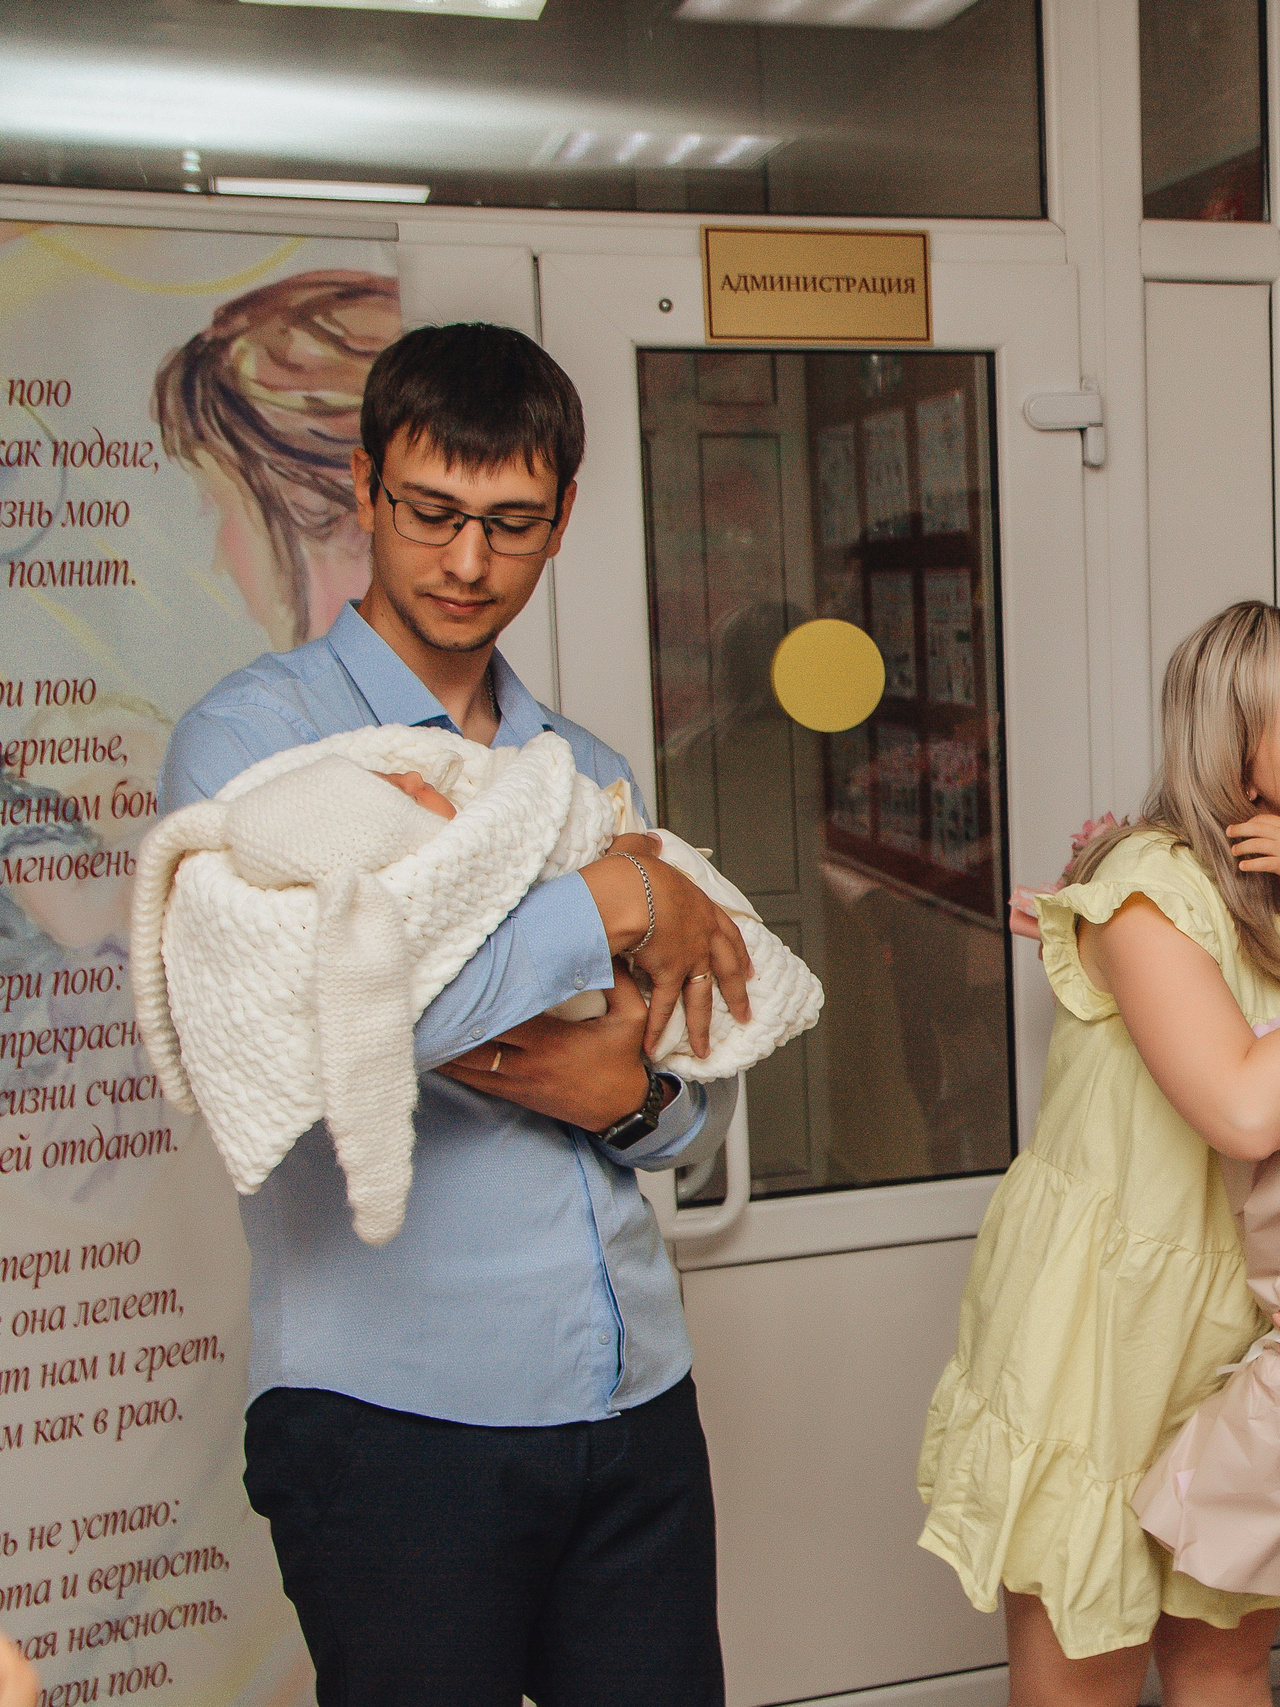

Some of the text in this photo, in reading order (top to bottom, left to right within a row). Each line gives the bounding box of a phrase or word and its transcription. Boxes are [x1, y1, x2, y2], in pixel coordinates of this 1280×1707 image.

[721, 274, 916, 296] АДМИНИСТРАЦИЯ
[8, 378, 72, 408] пою
[51, 426, 160, 473] подвиг,
[0, 500, 131, 529] знь мою
[8, 559, 137, 588] помнит.
[34, 677, 97, 706] пою
[0, 734, 129, 779] ерпенье,
[52, 964, 124, 996] пою:
[0, 1020, 143, 1069] прекрасн
[42, 1124, 178, 1169] отдают.
[81, 1238, 142, 1270] пою
[11, 1288, 184, 1337] она лелеет,
[41, 1355, 98, 1388] нам
[109, 1351, 126, 1377] и
[134, 1334, 225, 1382] греет,
[34, 1412, 85, 1445] как
[93, 1408, 109, 1434] в
[116, 1397, 183, 1442] раю.
[28, 1521, 62, 1552] не
[68, 1499, 180, 1555] устаю:
[61, 1573, 79, 1600] и
[88, 1546, 230, 1603] верность,
[68, 1600, 228, 1652] нежность.
[108, 1661, 173, 1697] пою.
